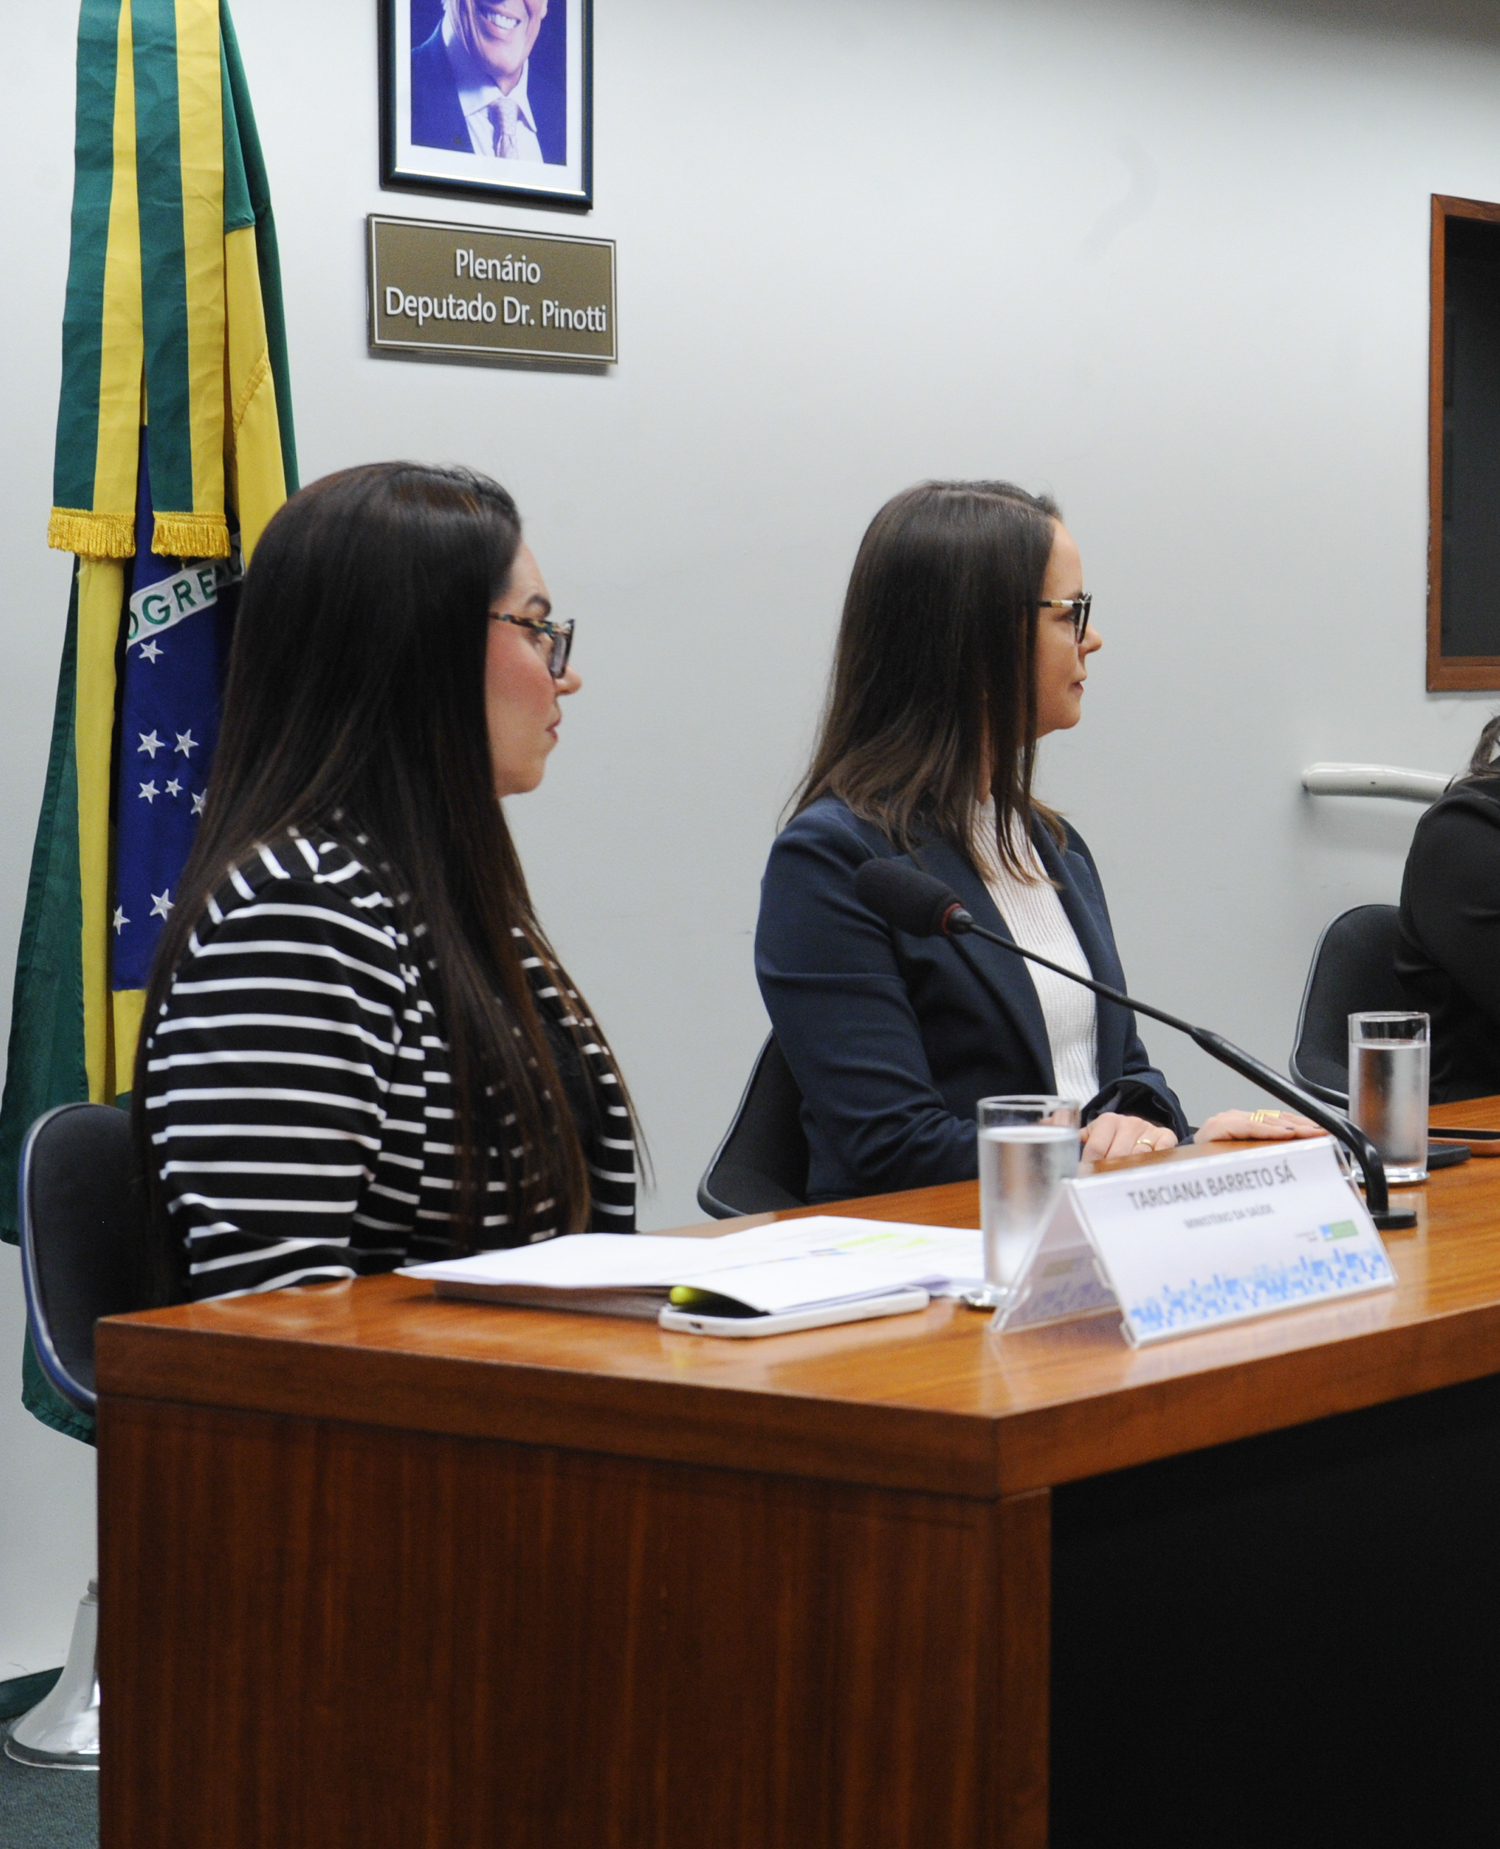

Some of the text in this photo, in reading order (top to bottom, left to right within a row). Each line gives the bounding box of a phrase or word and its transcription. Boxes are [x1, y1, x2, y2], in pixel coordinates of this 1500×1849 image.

[455, 248, 541, 284] Plenário
[385, 286, 607, 332] Deputado Dr. Pinotti
[1127, 1159, 1297, 1209] TARCIANA BARRETO SÁ
[1183, 1203, 1275, 1229] MINISTÉRIO DA SAÚDE
